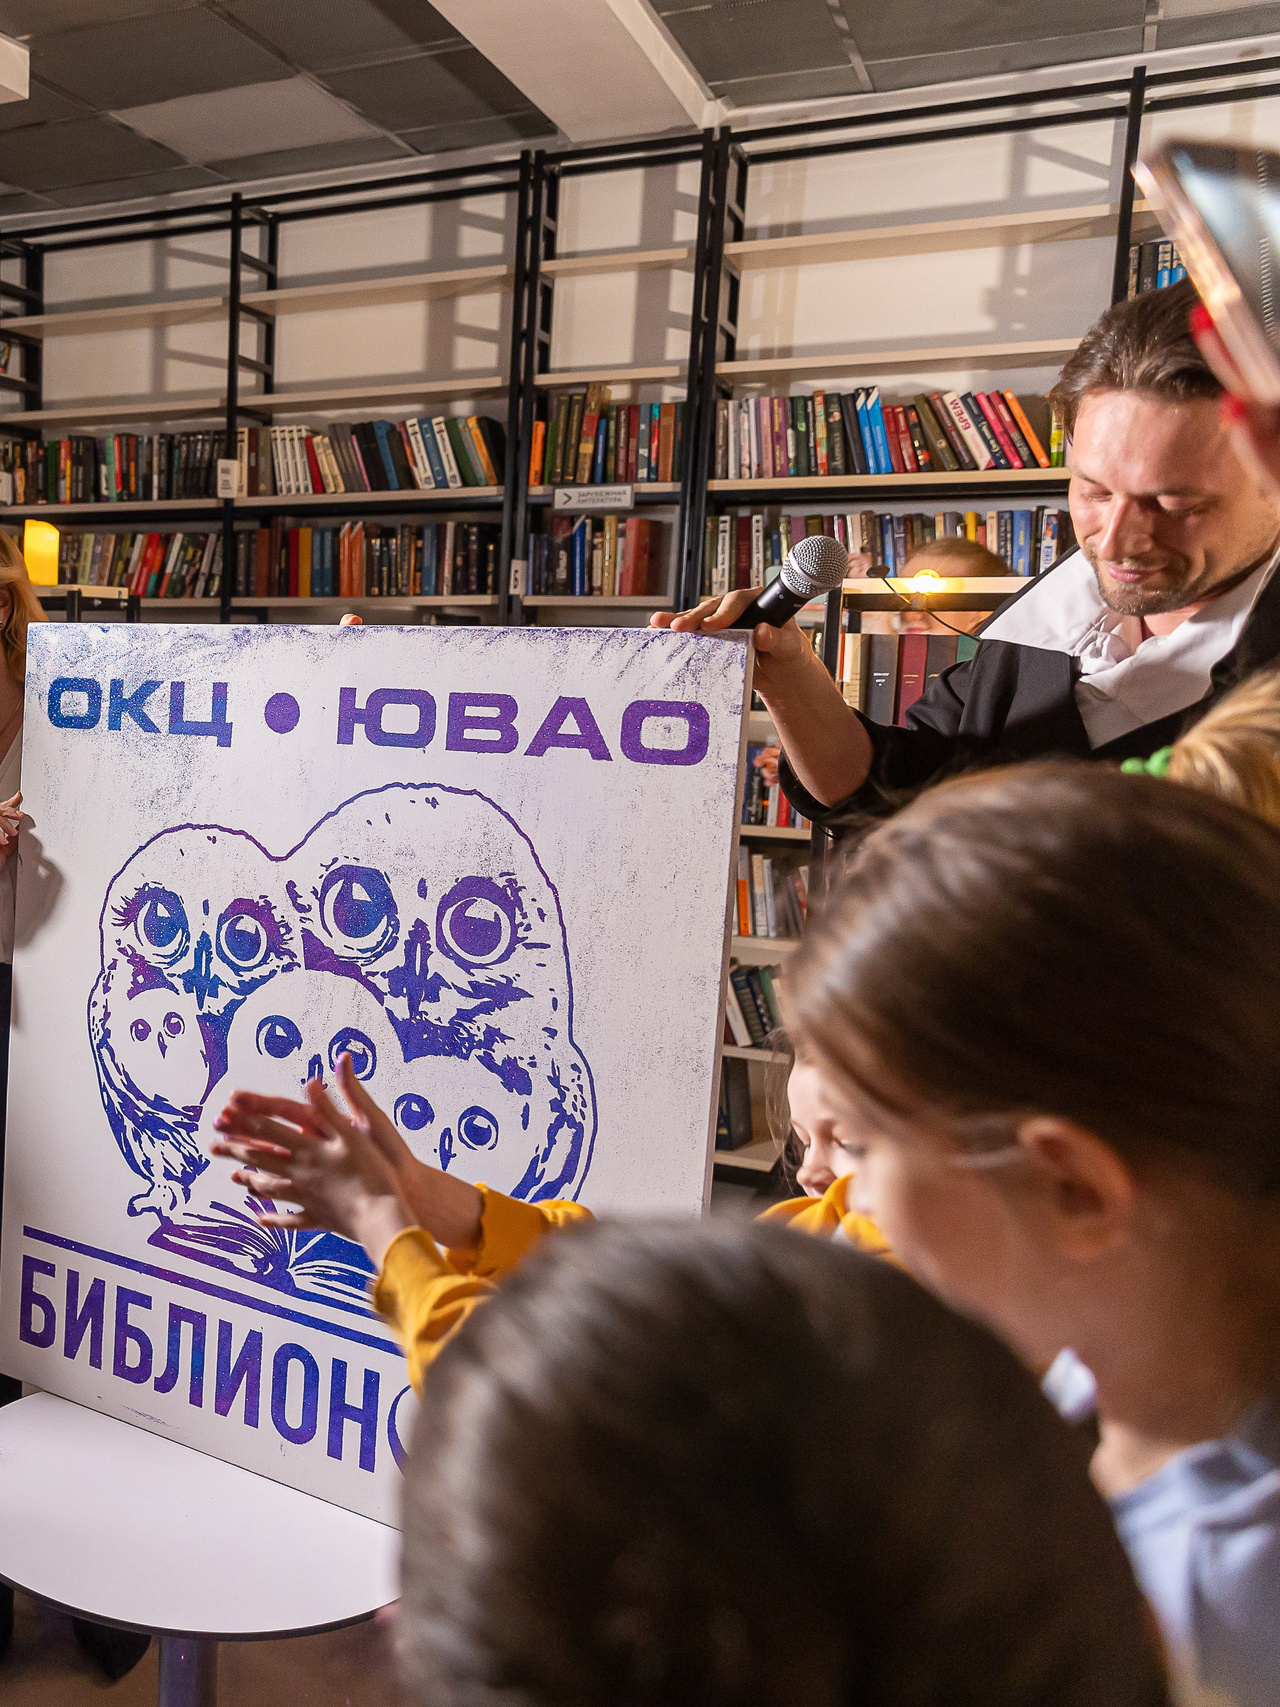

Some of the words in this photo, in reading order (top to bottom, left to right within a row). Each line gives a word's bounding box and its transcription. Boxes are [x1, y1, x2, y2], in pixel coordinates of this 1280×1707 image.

[949, 398, 972, 431] БРЕМ
[47, 676, 233, 747] ОКЦ
[337, 686, 710, 766] ЮВАО
[19, 1254, 408, 1482] БИБЛИОН
